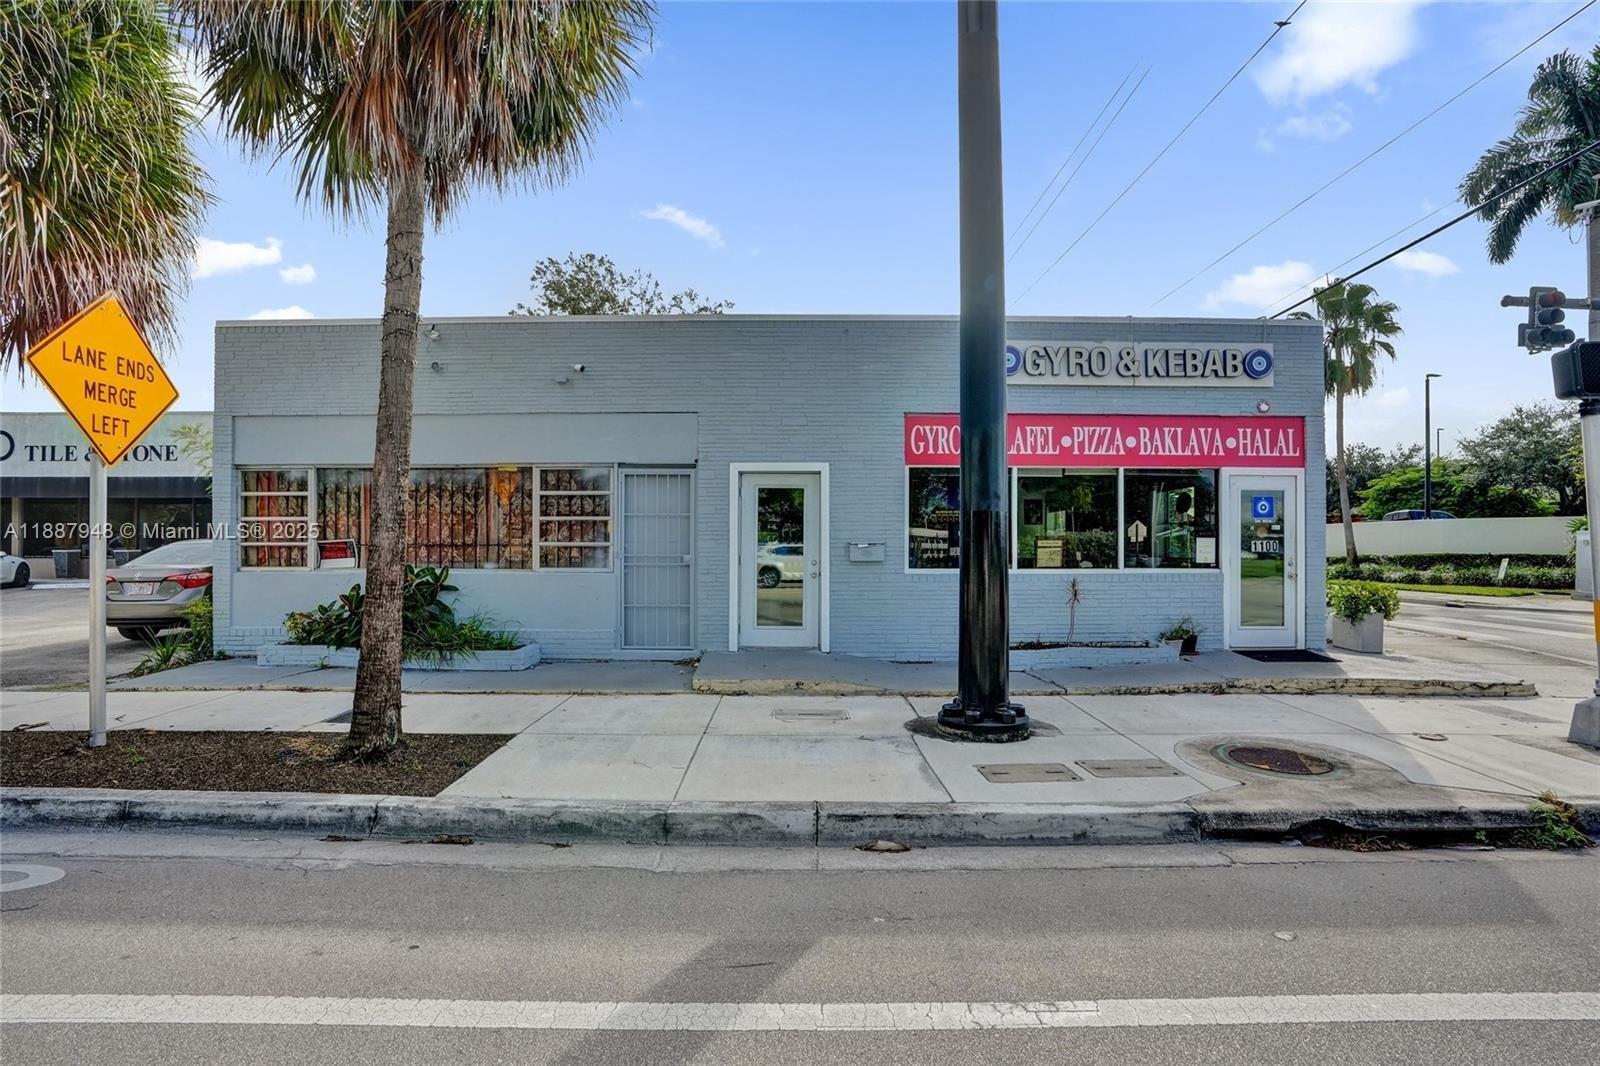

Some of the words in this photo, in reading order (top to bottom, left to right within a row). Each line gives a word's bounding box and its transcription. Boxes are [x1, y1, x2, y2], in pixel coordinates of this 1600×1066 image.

[62, 341, 107, 371] LANE
[117, 356, 155, 383] ENDS
[1023, 346, 1111, 377] GYRO
[1116, 347, 1141, 377] &
[1144, 348, 1244, 378] KEBAB
[84, 379, 137, 409] MERGE
[92, 413, 130, 437] LEFT
[25, 445, 78, 462] TILE
[123, 445, 178, 461] ONE
[1007, 426, 1060, 455] AFEL
[1072, 426, 1126, 455] PIZZA
[1138, 427, 1225, 456] BAKLAVA
[1237, 428, 1300, 457] HALAL
[1252, 541, 1278, 552] 1100
